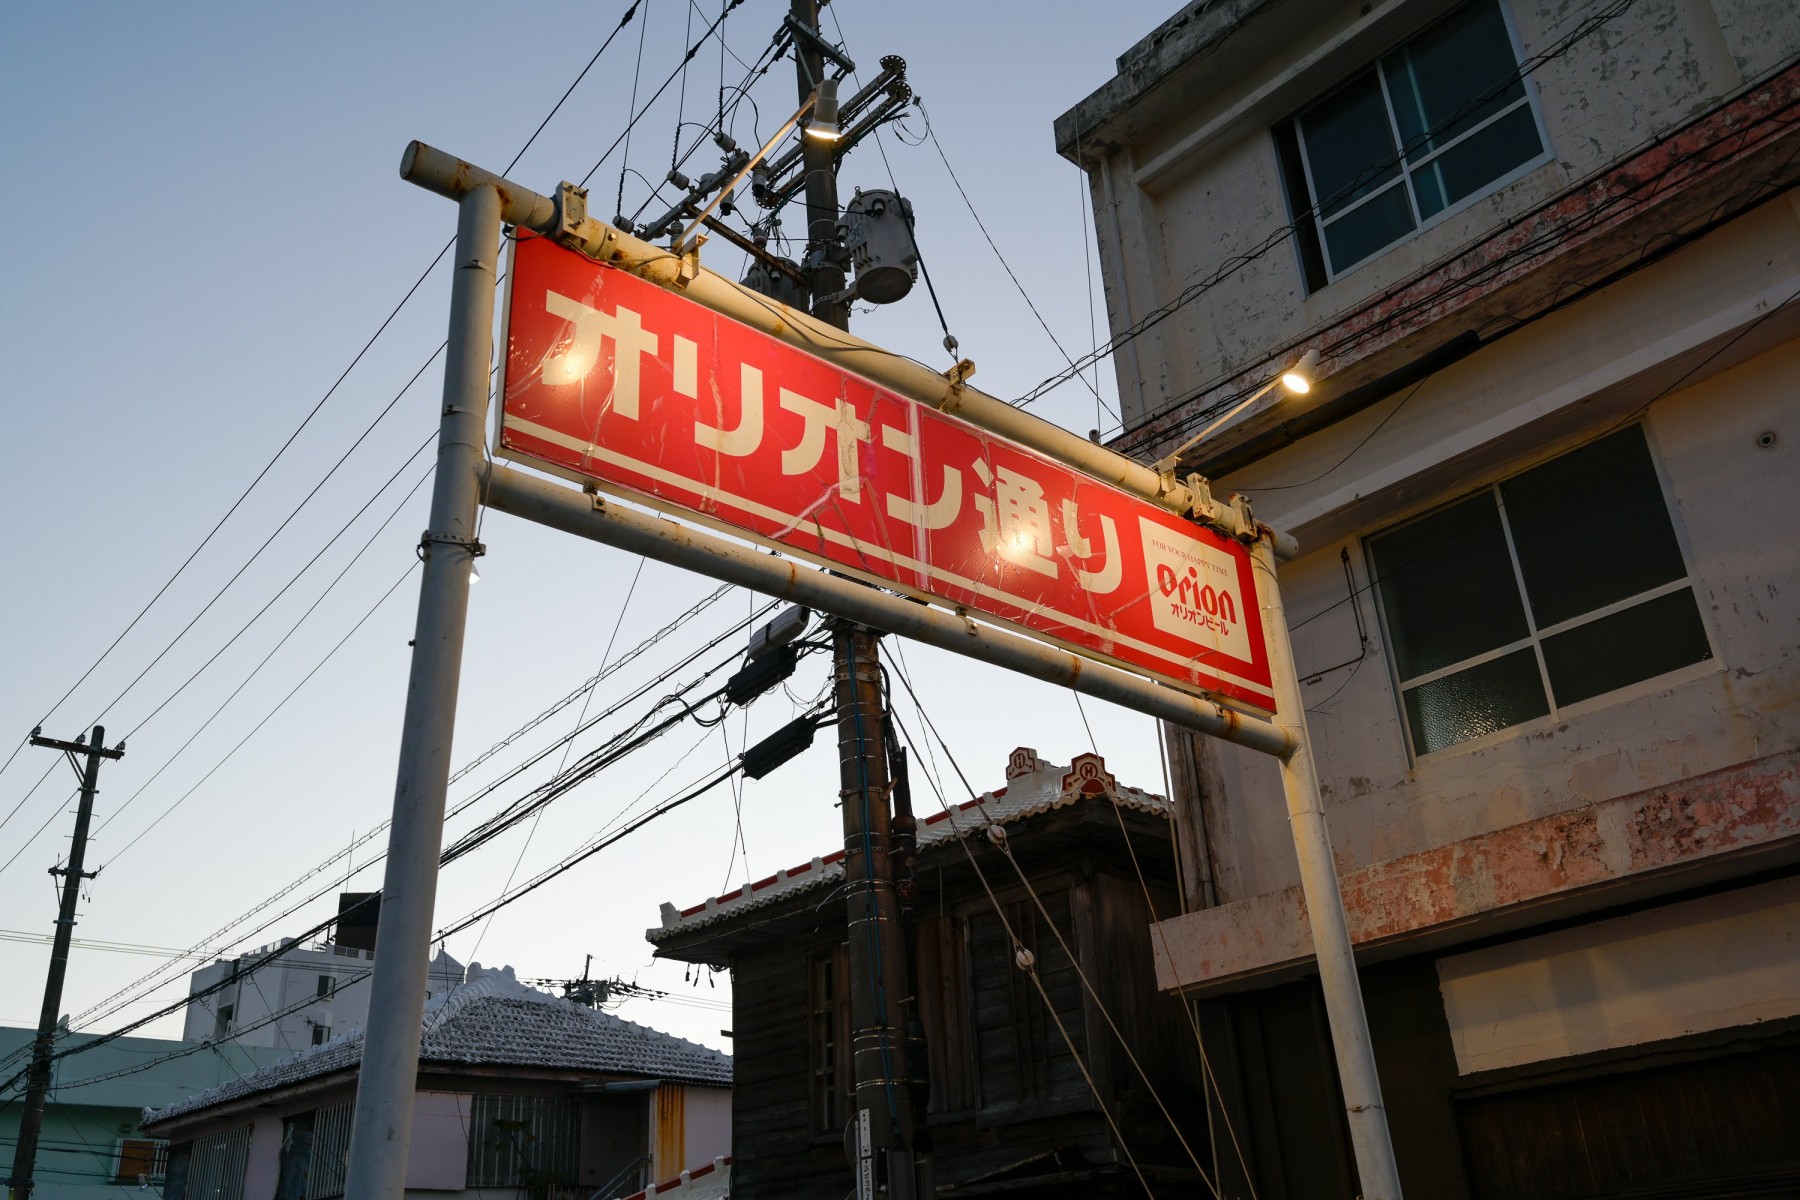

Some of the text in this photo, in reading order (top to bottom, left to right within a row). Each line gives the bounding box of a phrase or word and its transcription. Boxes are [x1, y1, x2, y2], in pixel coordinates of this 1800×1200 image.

[541, 290, 1122, 594] オリオン通り
[1152, 539, 1229, 577] FOR YOUR HAPPY TIME
[1171, 603, 1229, 636] オリオンビール
